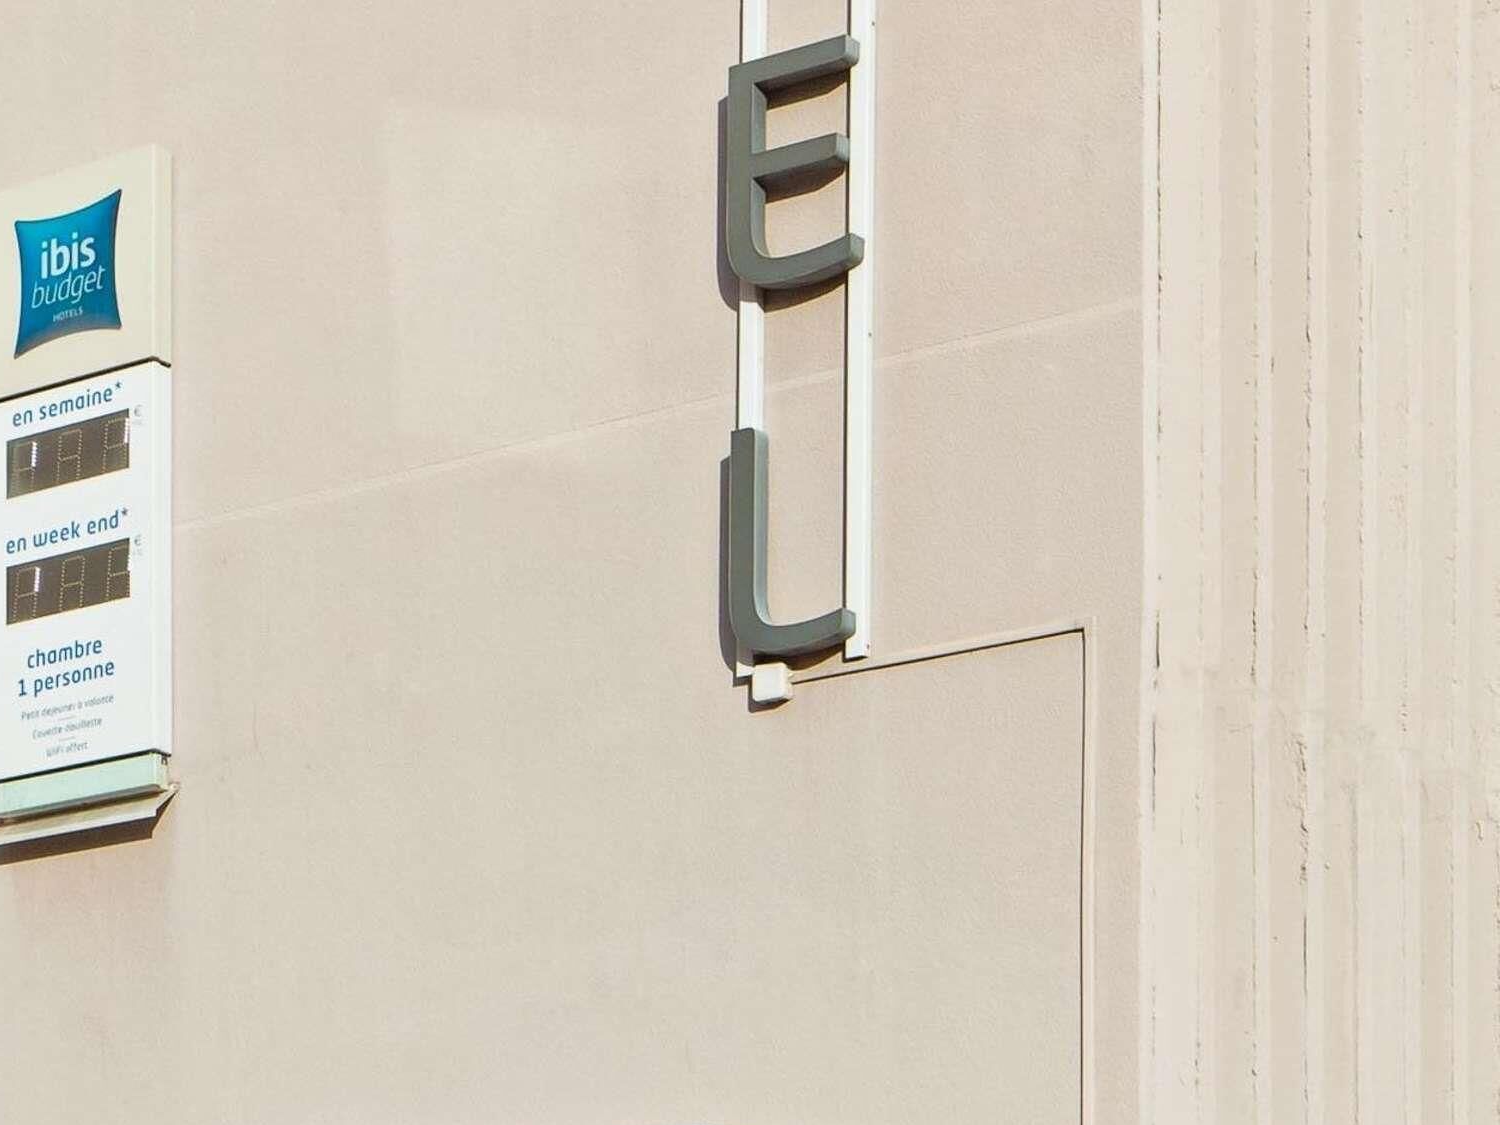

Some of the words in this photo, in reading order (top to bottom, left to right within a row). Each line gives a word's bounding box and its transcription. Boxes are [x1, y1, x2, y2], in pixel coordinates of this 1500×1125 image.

[40, 232, 96, 279] ibis
[32, 265, 106, 309] budget
[53, 307, 83, 322] HOTELS
[12, 409, 33, 427] en
[6, 534, 27, 554] en
[32, 520, 81, 546] week
[27, 639, 103, 669] chambre
[18, 679, 27, 697] 1
[34, 660, 115, 697] personne
